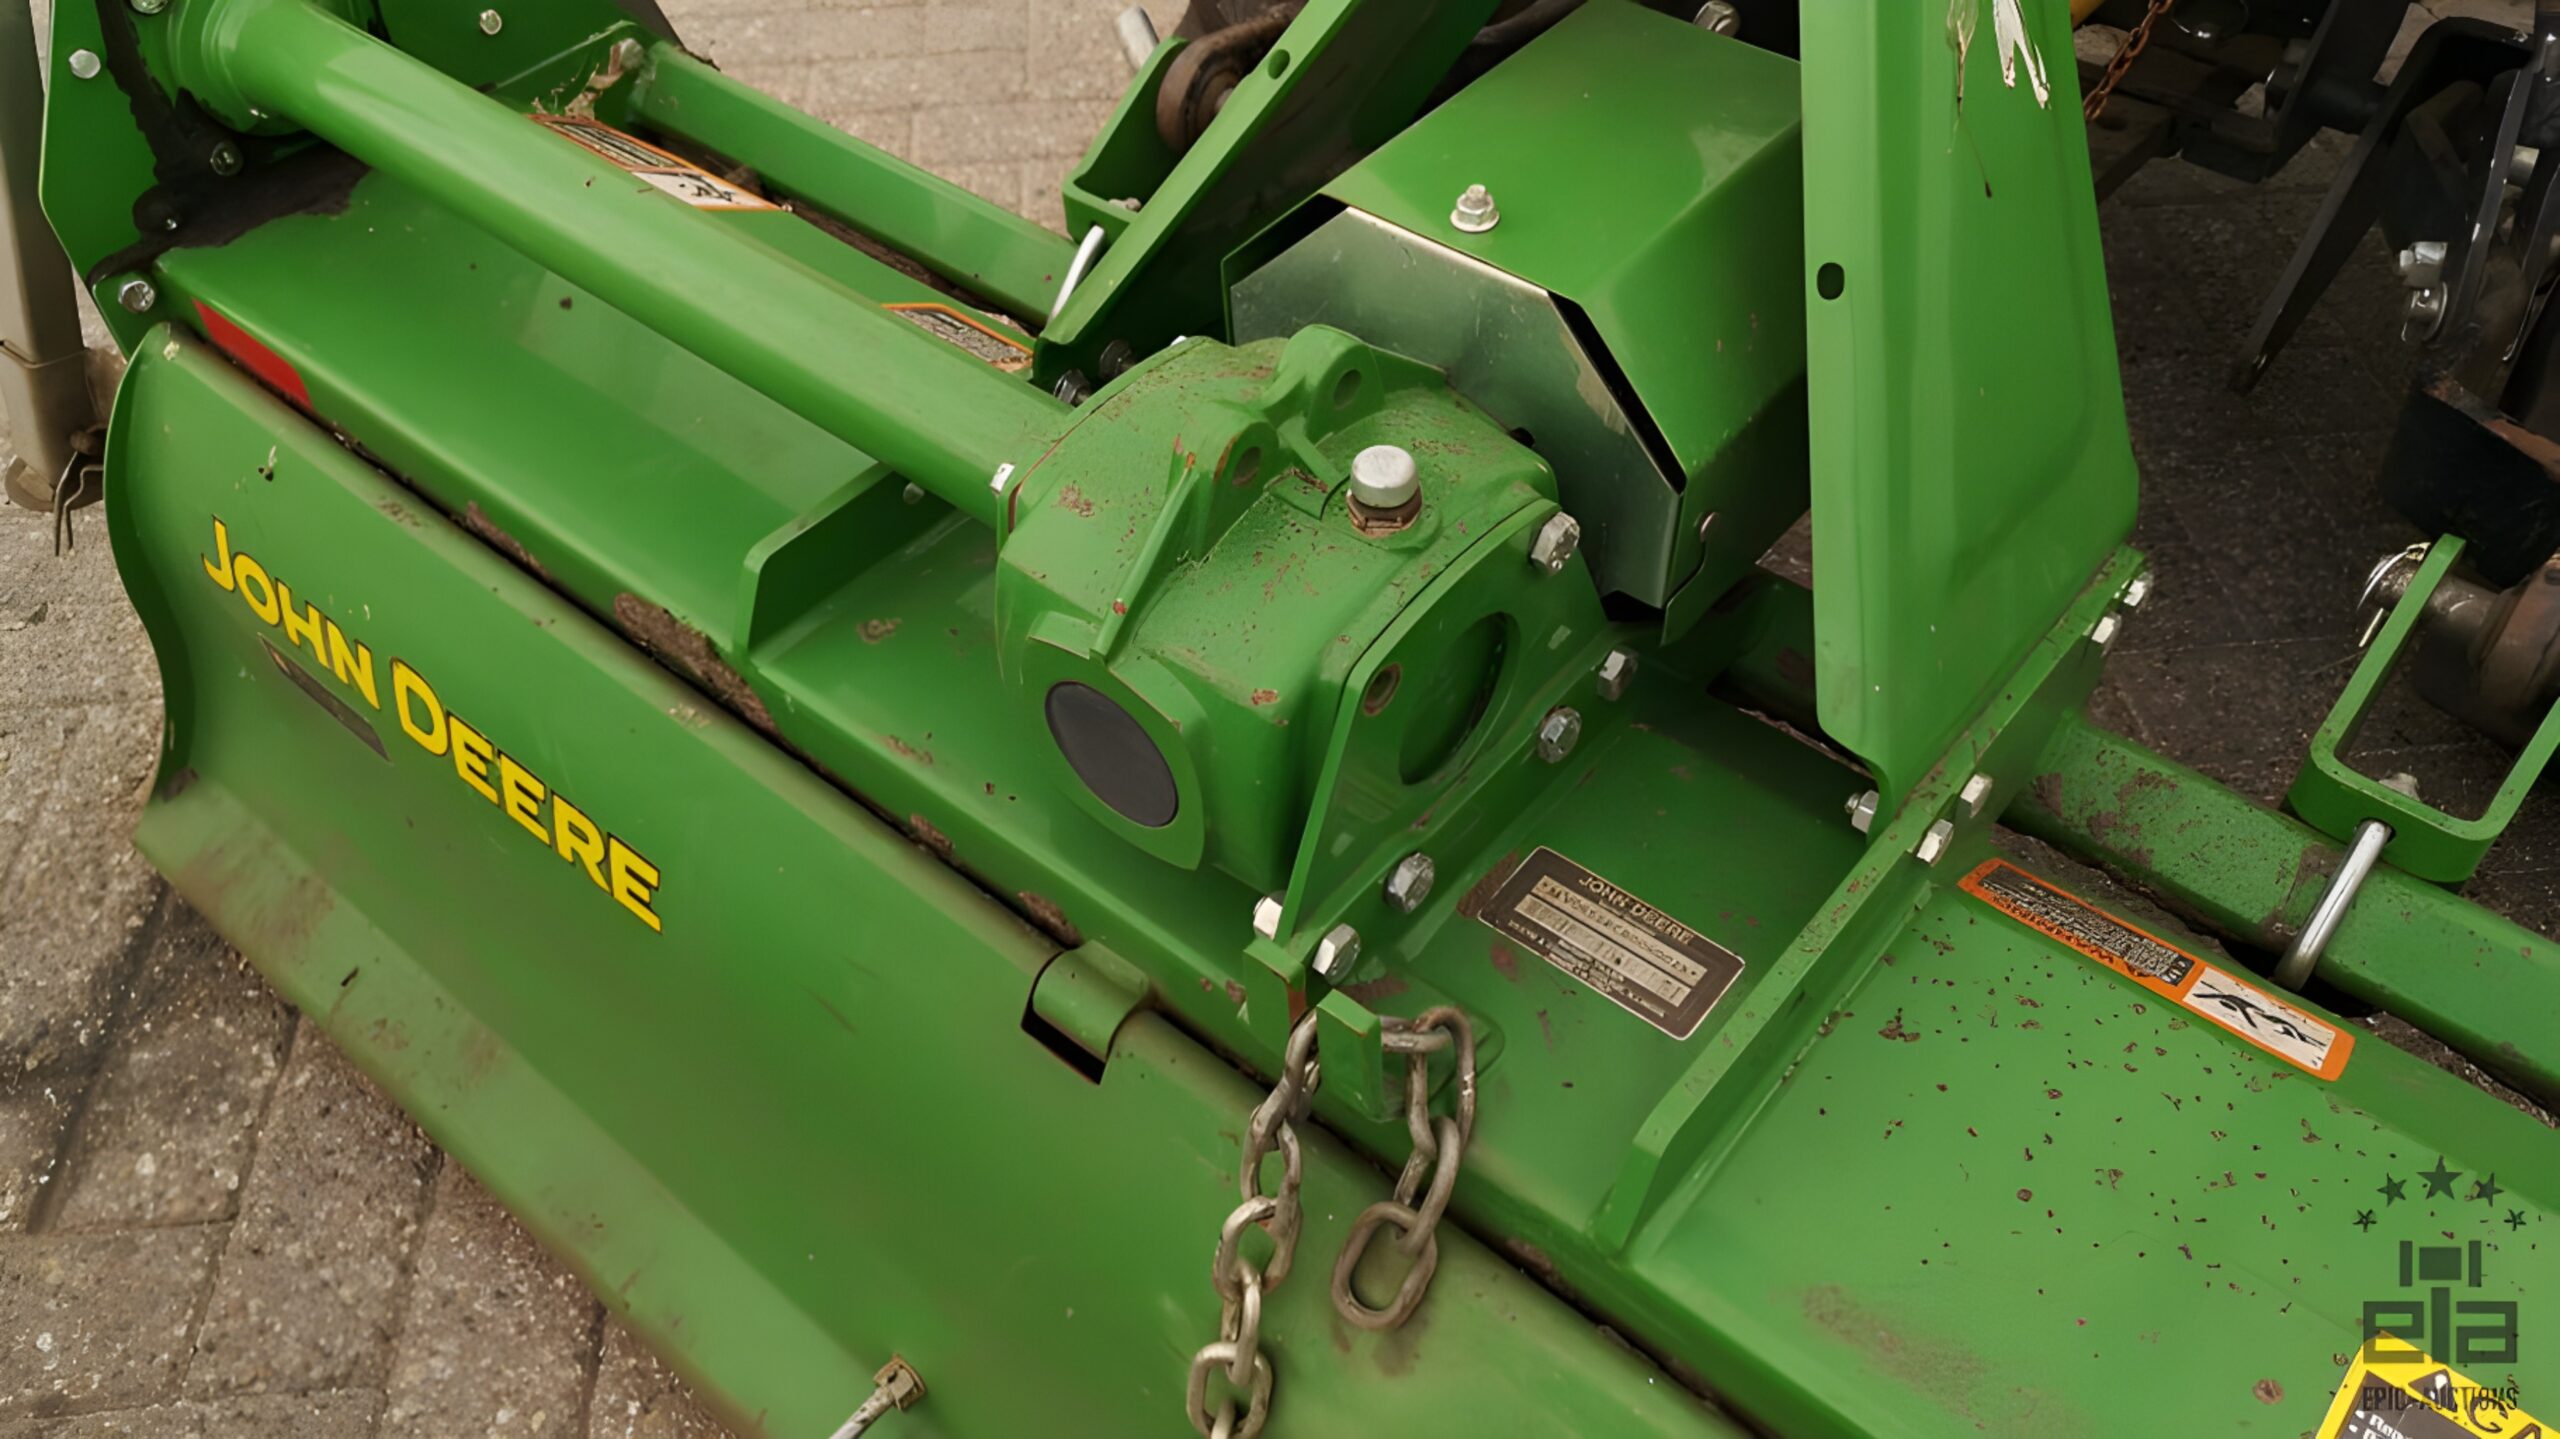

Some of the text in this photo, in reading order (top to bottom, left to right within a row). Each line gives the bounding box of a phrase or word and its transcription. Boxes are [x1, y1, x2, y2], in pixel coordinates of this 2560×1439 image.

[201, 514, 662, 934] JOHN DEERE
[1578, 877, 1630, 908] JOHN
[1629, 903, 1695, 945] DEERE
